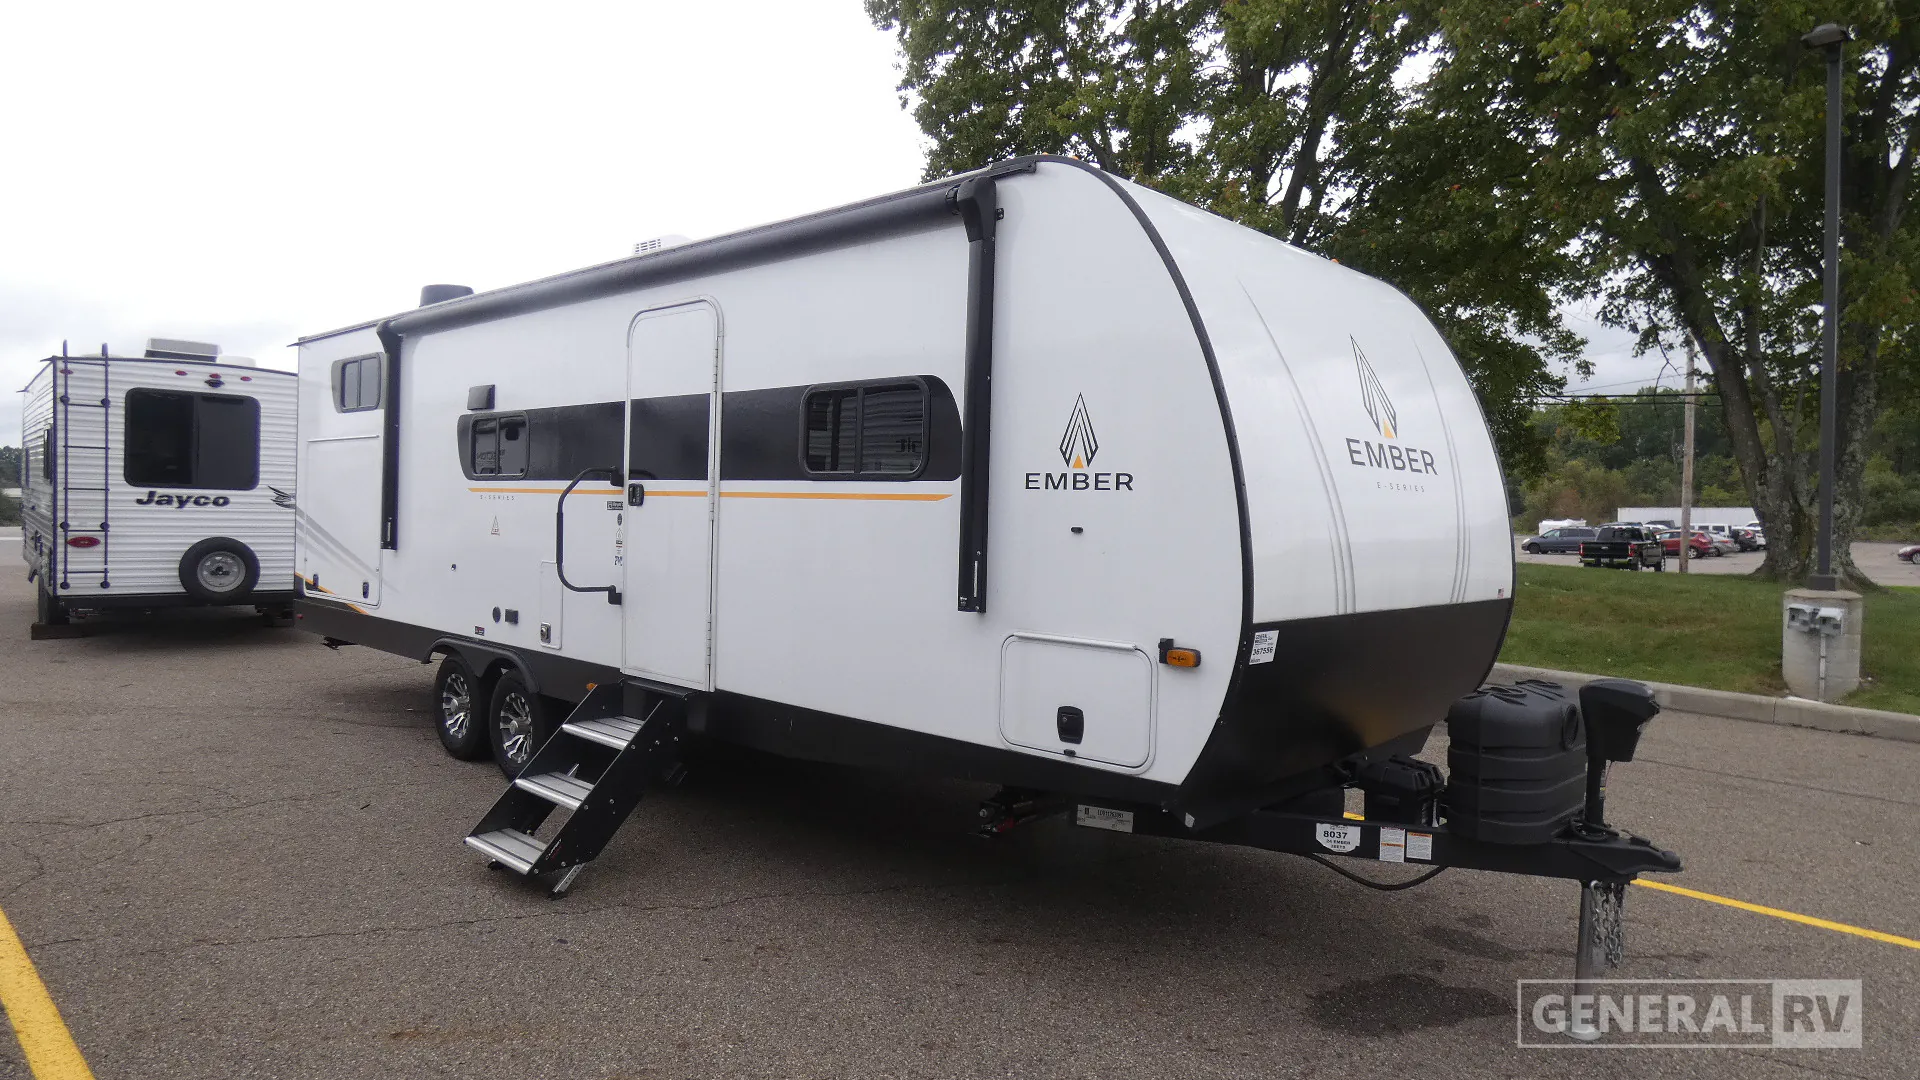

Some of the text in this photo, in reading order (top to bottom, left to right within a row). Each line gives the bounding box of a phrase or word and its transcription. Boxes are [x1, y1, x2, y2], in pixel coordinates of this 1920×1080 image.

[1345, 437, 1438, 476] EMBER
[1025, 472, 1134, 491] EMBER
[1376, 481, 1425, 493] E-SERIES
[136, 490, 231, 509] Jayco
[1323, 830, 1348, 839] 8037
